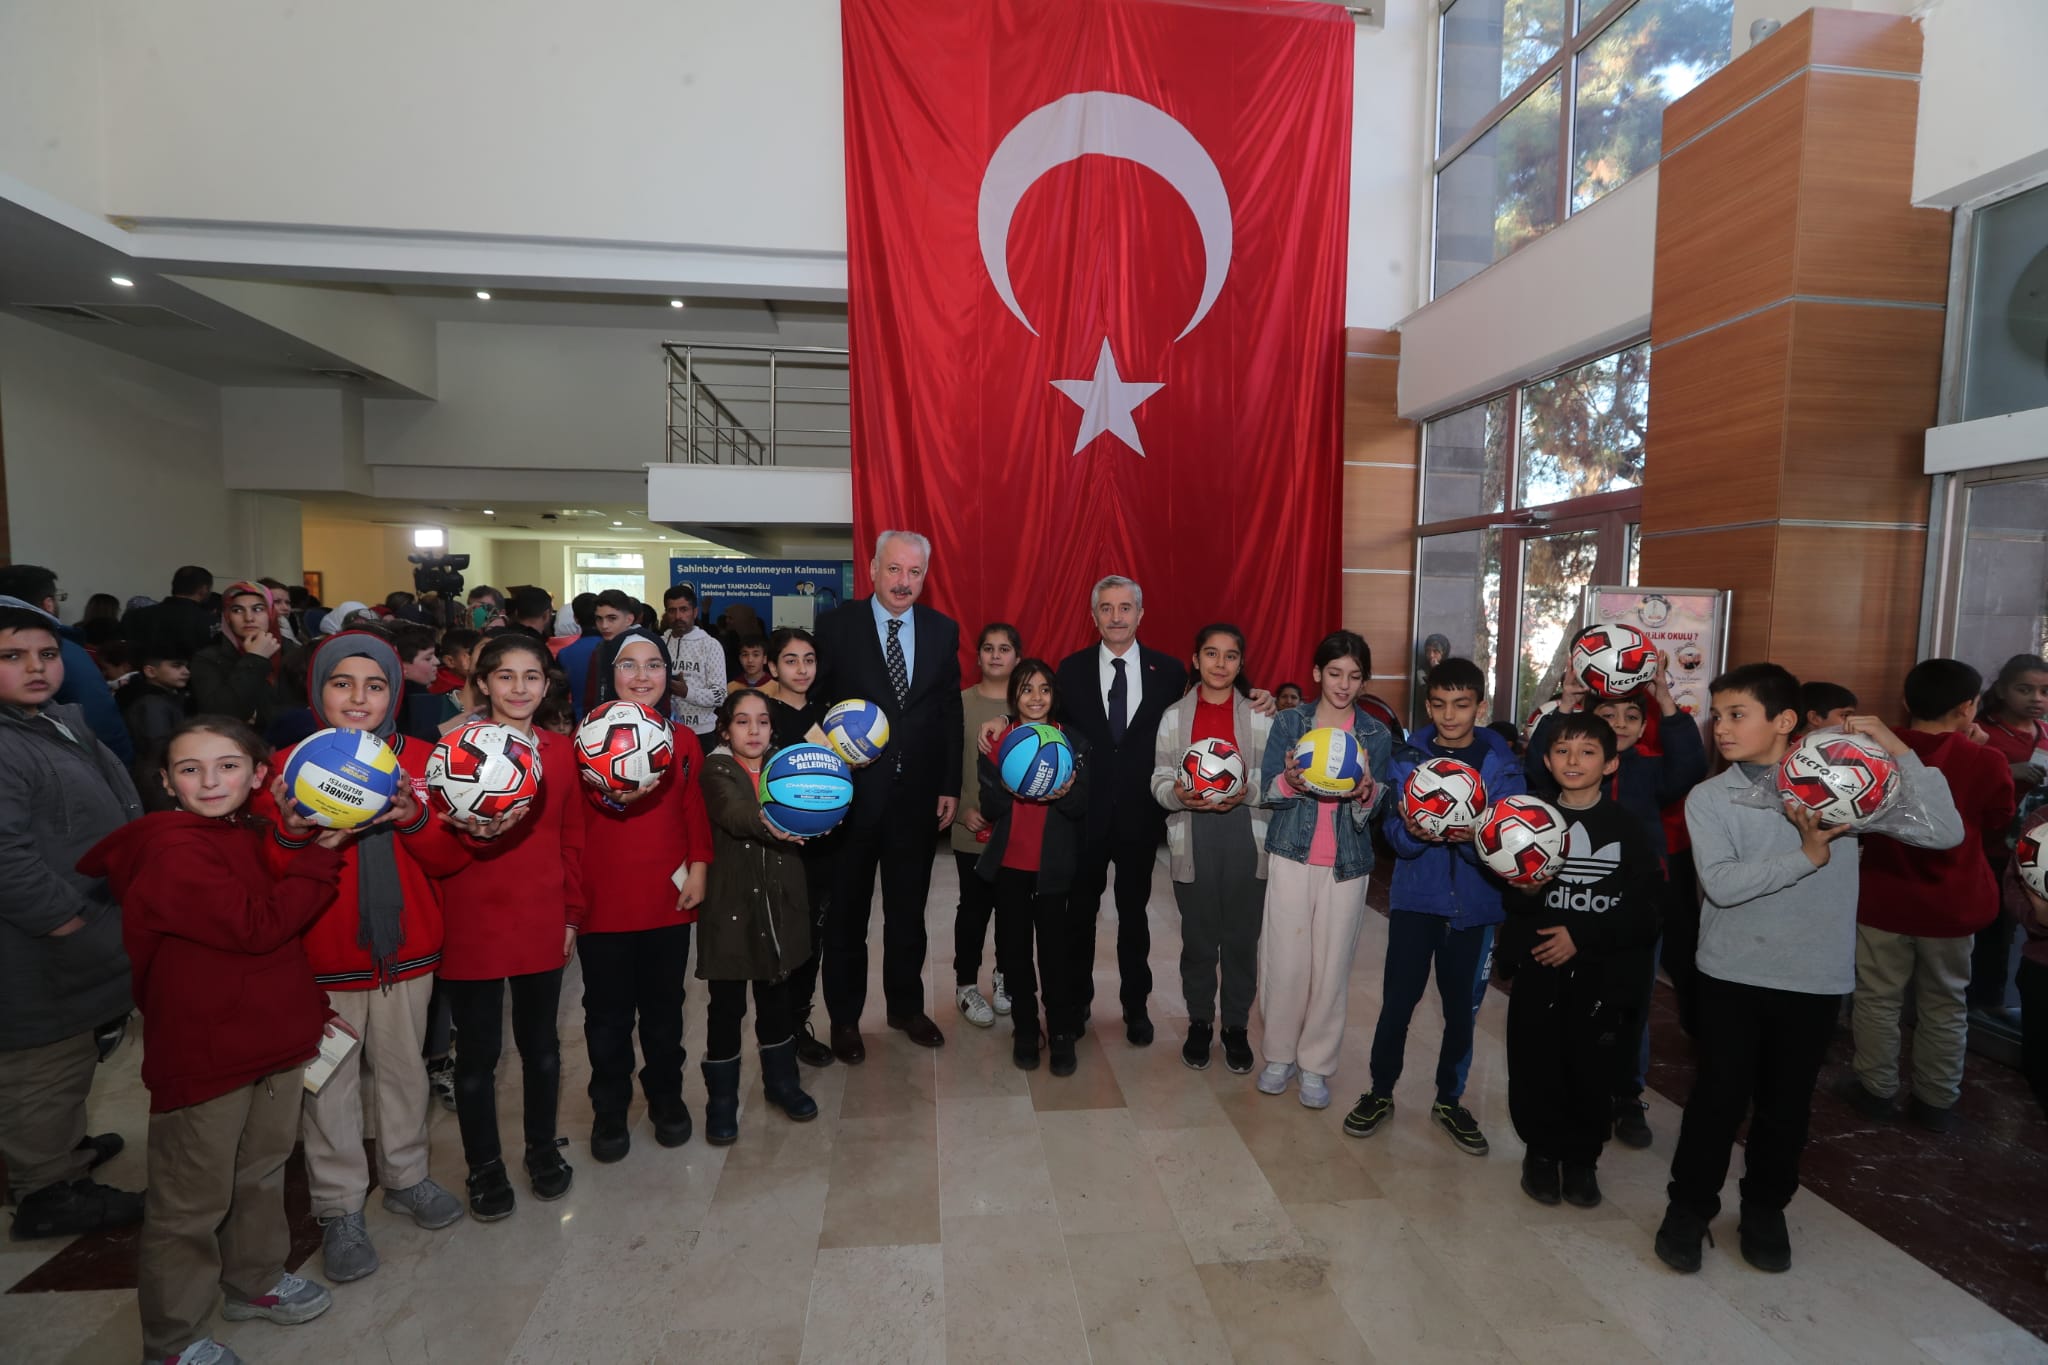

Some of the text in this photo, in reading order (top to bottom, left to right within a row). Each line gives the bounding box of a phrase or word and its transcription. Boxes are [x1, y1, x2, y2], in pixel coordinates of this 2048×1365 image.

[677, 564, 836, 575] Şahinbey'de Evlenmeyen Kalmasın
[1667, 631, 1693, 641] OKULU
[1610, 671, 1649, 687] VECTOR
[1795, 753, 1840, 781] VECTOR
[1545, 885, 1622, 913] didas
